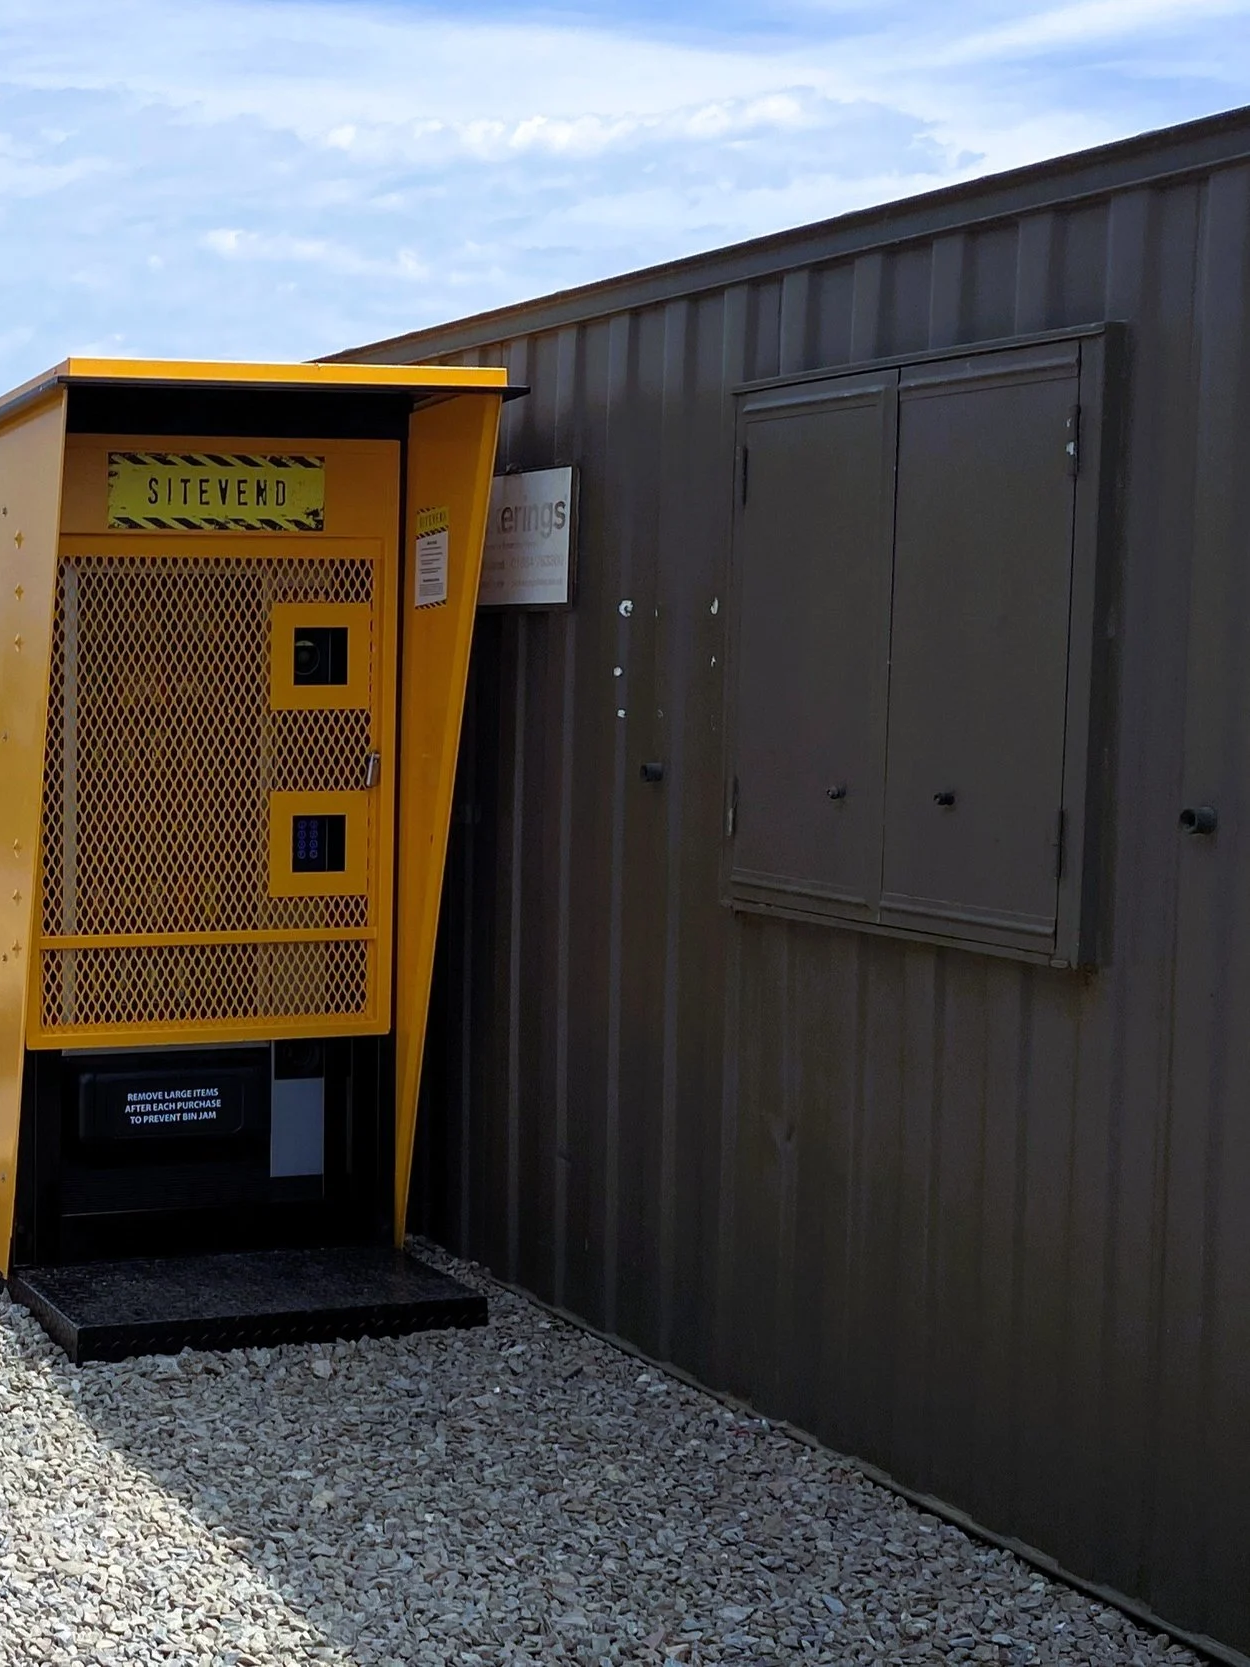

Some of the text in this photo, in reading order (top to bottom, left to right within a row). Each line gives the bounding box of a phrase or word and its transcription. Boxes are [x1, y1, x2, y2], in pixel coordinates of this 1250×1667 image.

[147, 477, 286, 507] SITEVEND
[497, 500, 566, 540] erings
[127, 1088, 218, 1102] REMOVE LARGE ITEMS
[125, 1099, 222, 1113] AFTER EACH PURCHASE
[130, 1111, 217, 1124] TO PREVENT BIN JAM
